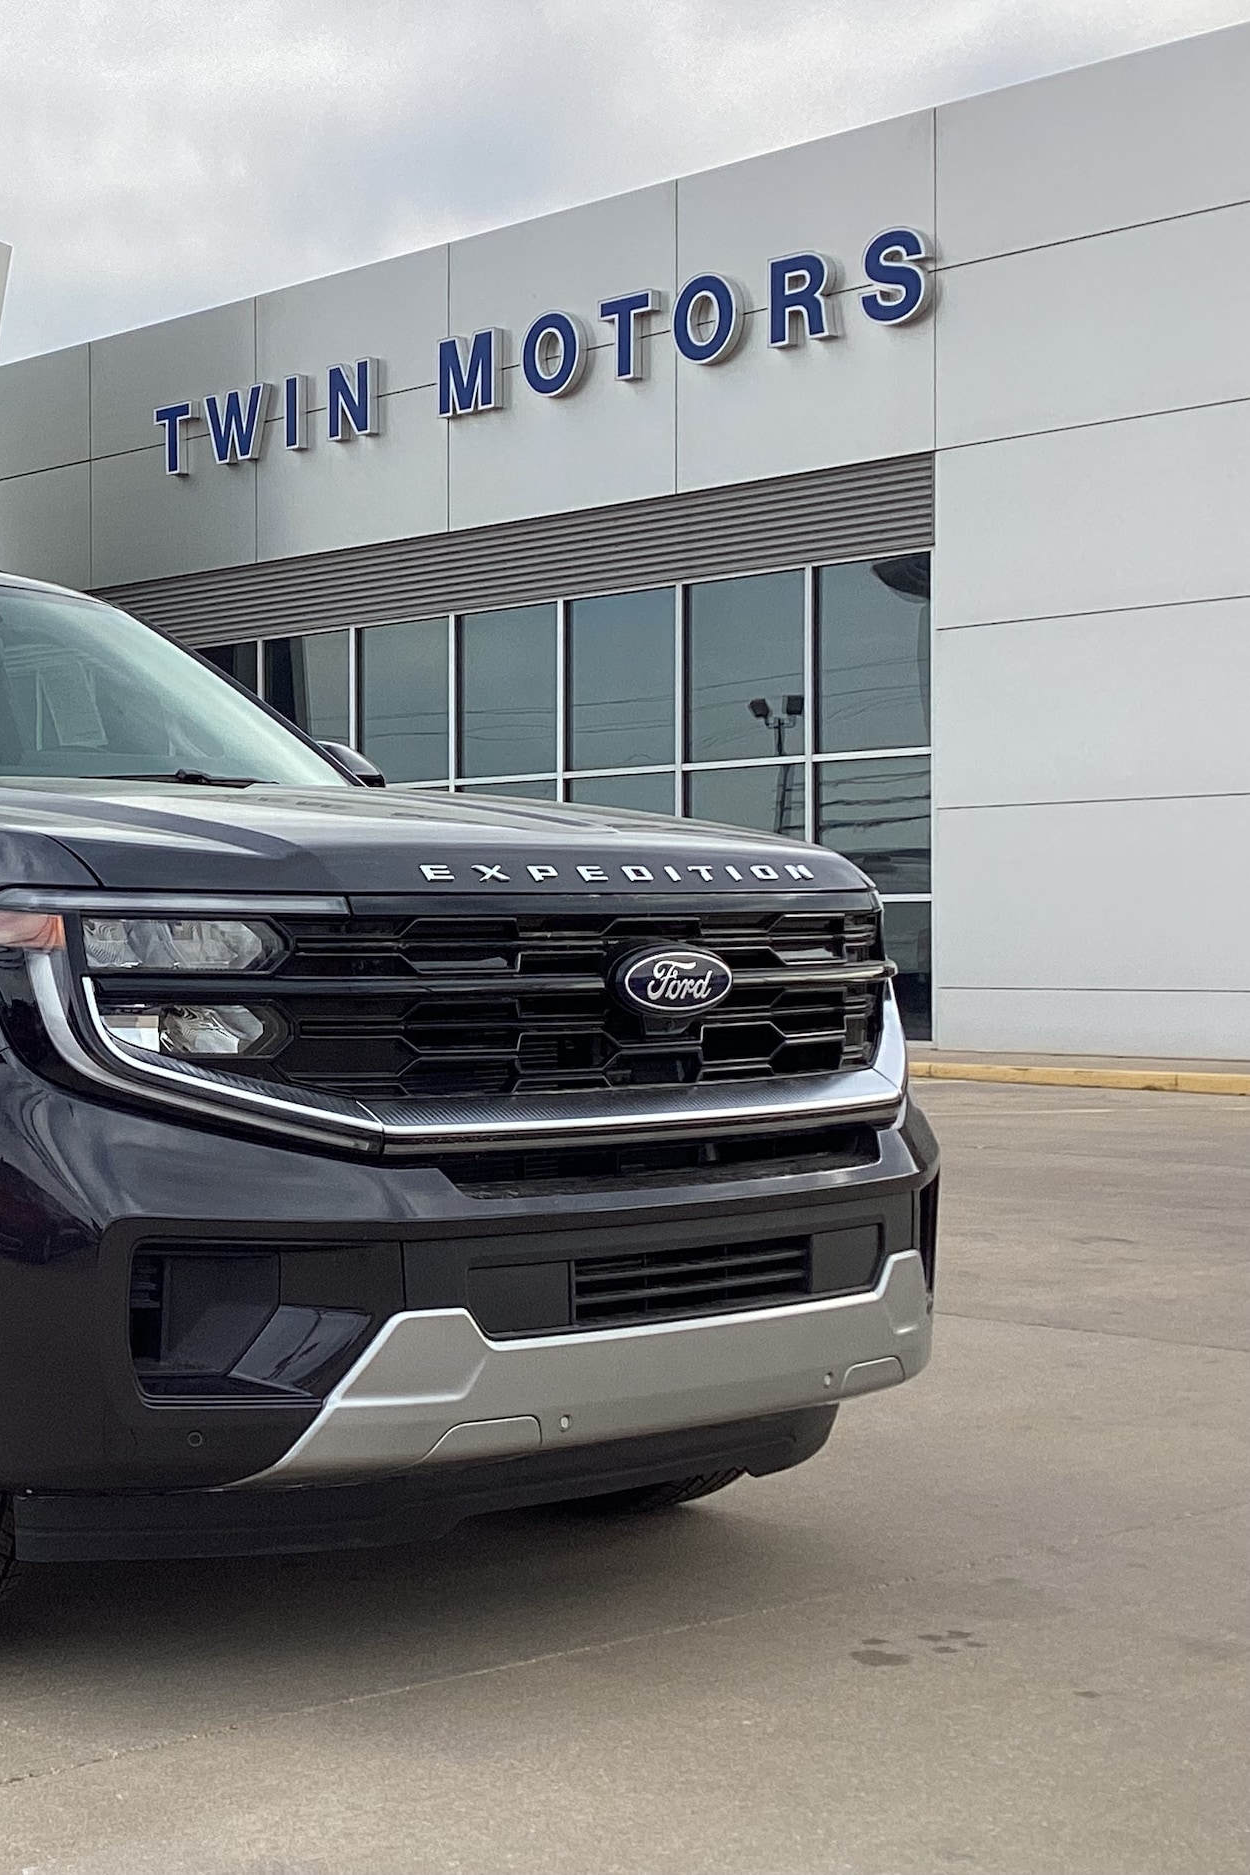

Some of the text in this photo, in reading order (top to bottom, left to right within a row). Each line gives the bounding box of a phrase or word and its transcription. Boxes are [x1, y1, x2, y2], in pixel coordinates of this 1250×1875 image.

[154, 226, 933, 476] TWIN MOTORS
[419, 864, 815, 882] EXPEDITION
[647, 960, 713, 1000] Ford
